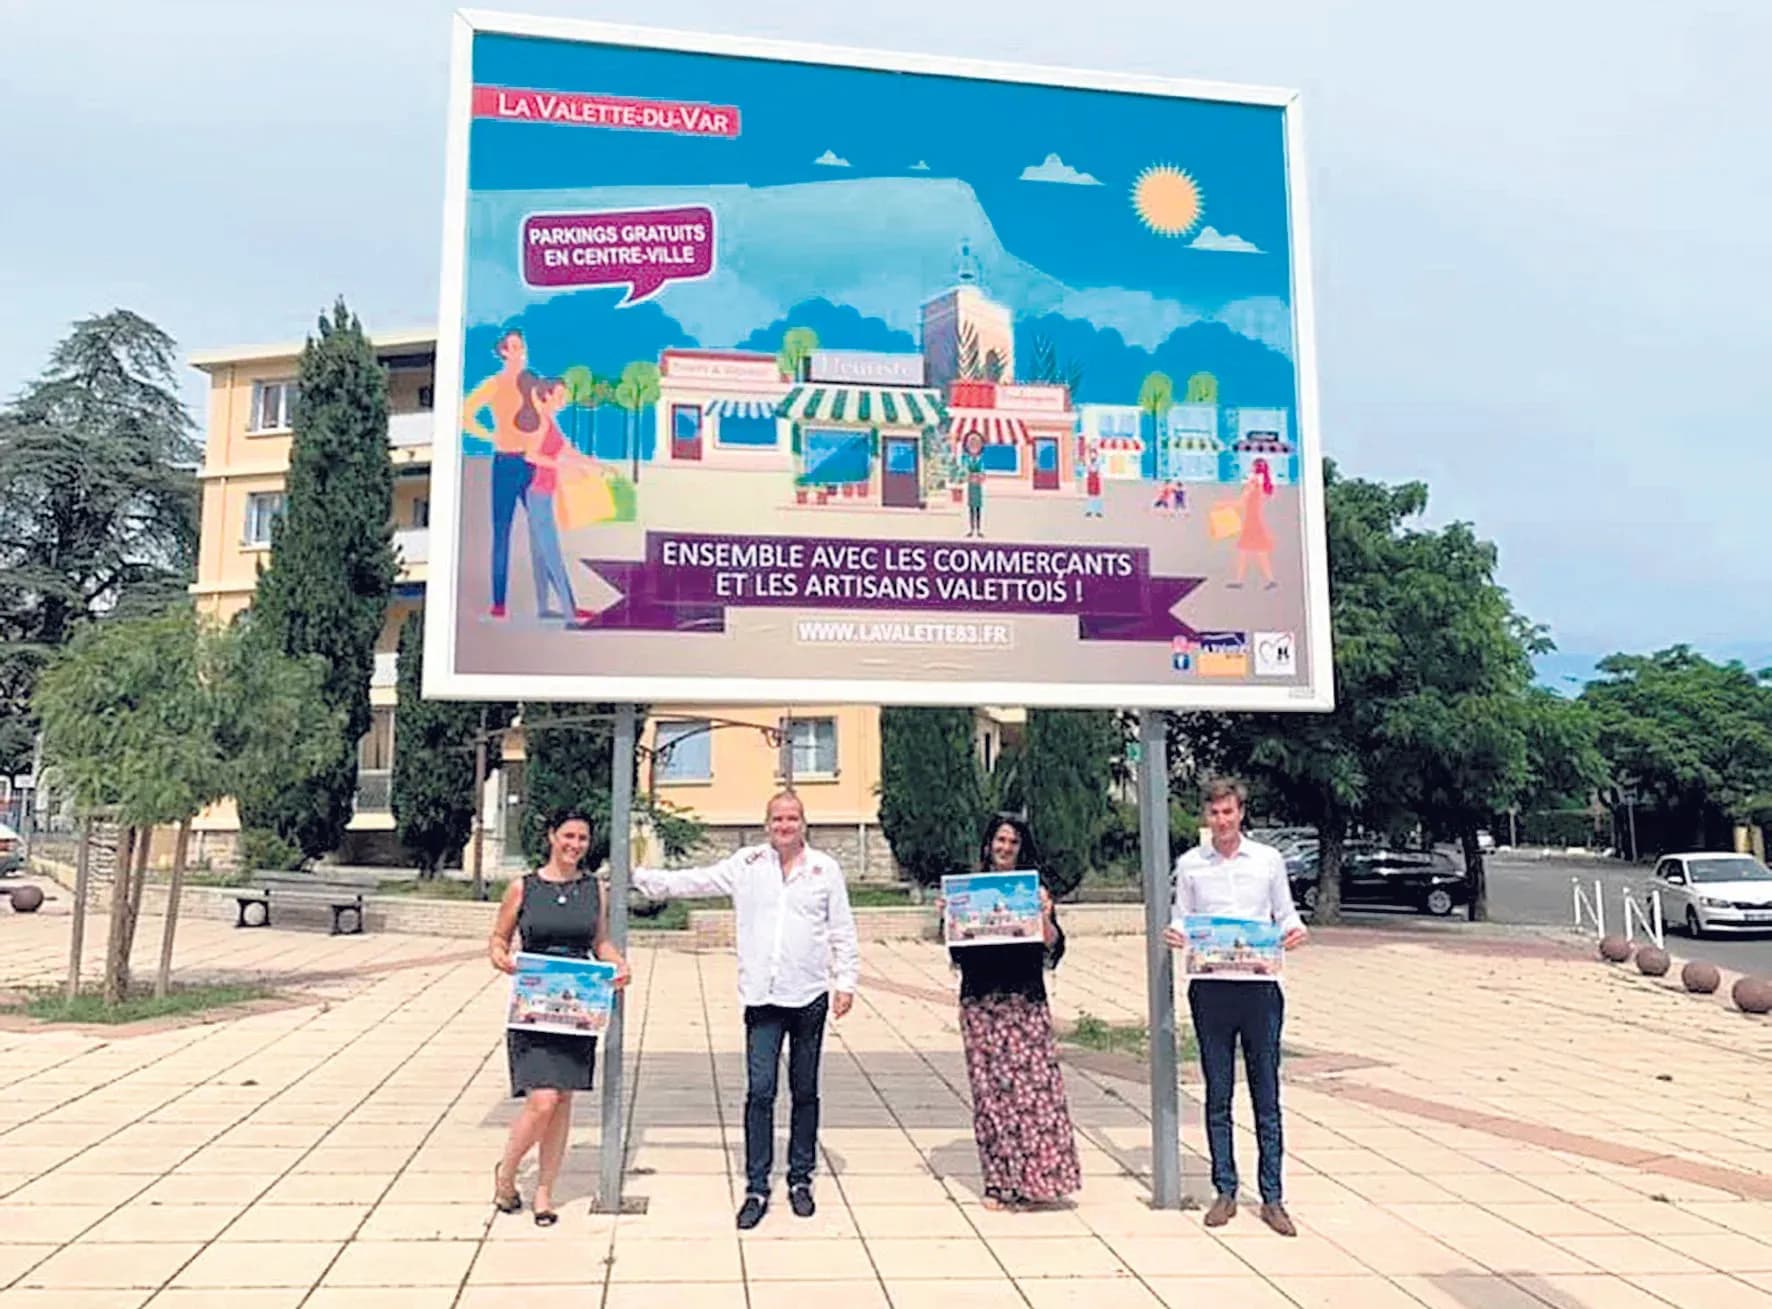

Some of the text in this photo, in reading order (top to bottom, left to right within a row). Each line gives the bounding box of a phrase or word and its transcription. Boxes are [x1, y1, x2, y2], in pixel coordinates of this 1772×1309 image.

[529, 224, 706, 246] PARKINGS GRATUITS
[545, 246, 695, 266] EN CENTRE-VILLE
[663, 541, 1132, 579] ENSEMBLE AVEC LES COMMERÇANTS
[716, 572, 1084, 602] ET LES ARTISANS VALETTOIS !
[799, 622, 1009, 645] WWW.LAVALETTE83.FR
